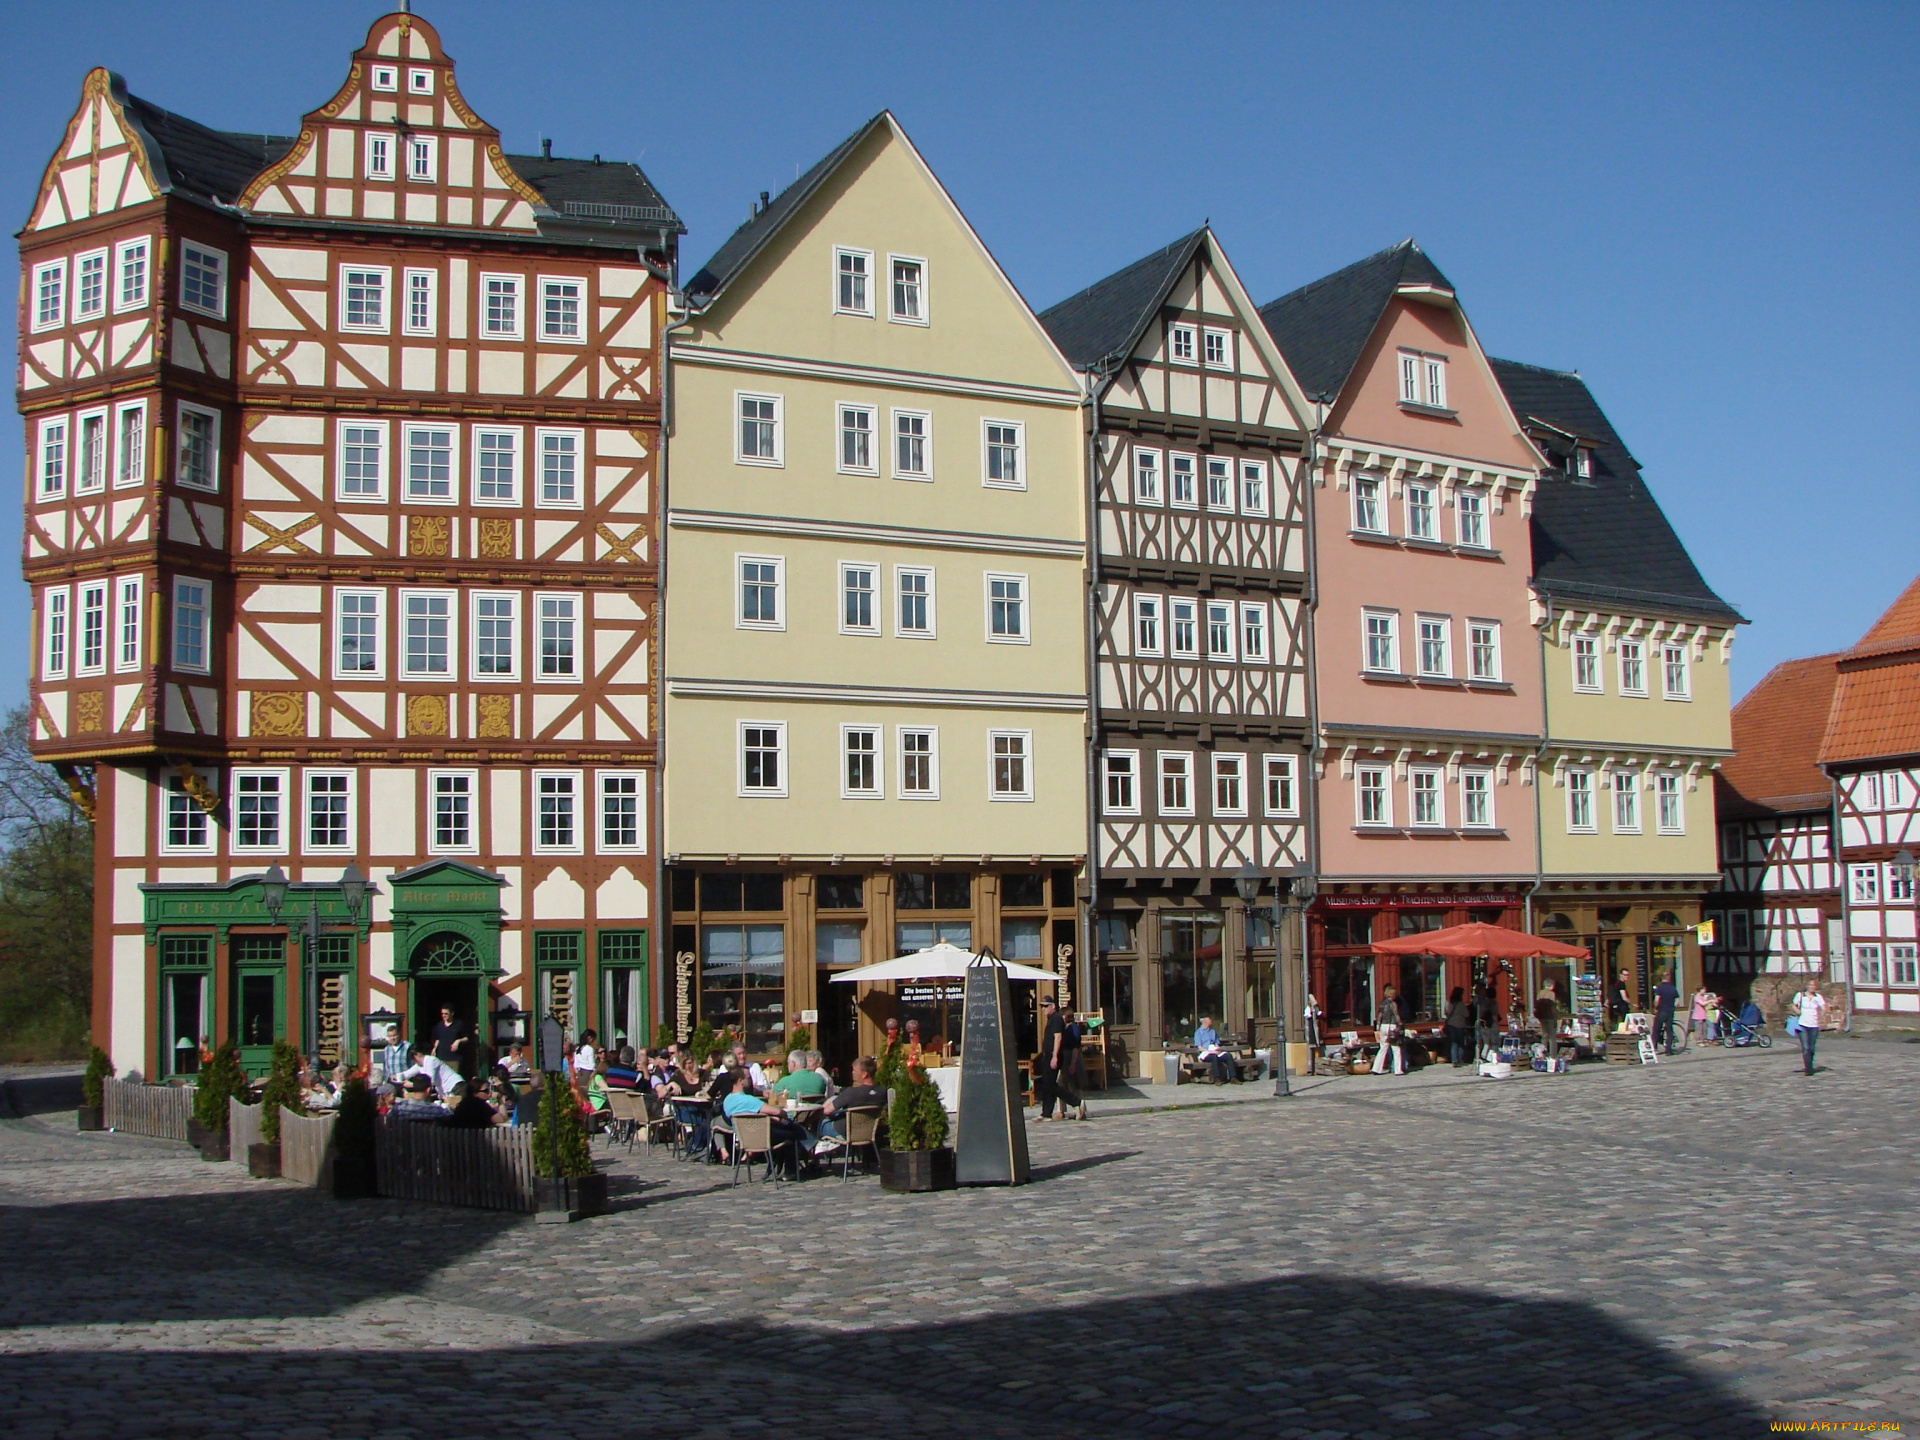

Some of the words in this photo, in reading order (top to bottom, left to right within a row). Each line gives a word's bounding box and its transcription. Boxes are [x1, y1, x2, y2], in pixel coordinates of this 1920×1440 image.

[403, 891, 437, 902] Alter
[446, 890, 488, 902] Markt
[177, 901, 337, 914] RESTAUAT
[904, 987, 914, 995] Die
[318, 978, 344, 1065] Bistro
